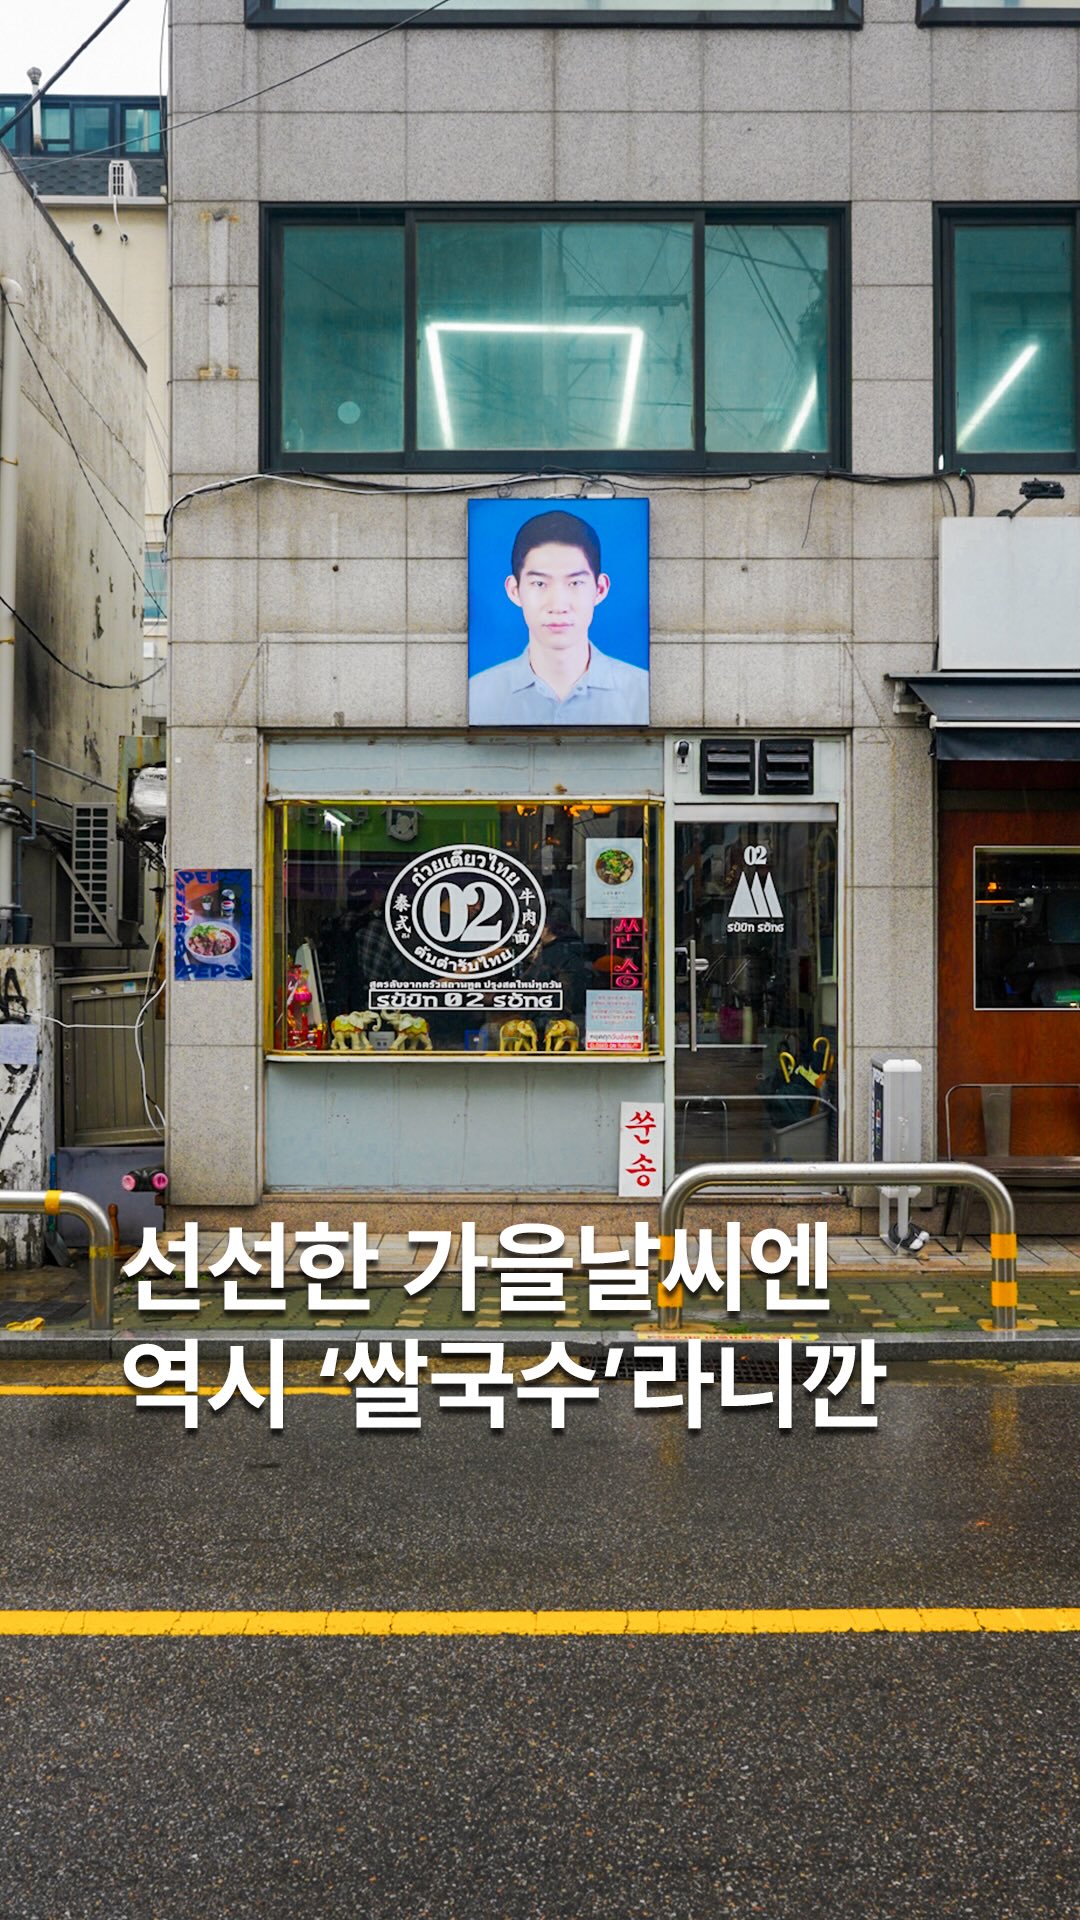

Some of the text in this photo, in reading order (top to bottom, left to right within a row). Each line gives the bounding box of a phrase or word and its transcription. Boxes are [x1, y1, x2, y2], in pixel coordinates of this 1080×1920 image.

[744, 845, 767, 866] 02
[422, 881, 503, 942] 02
[444, 992, 485, 1008] 02
[625, 1110, 657, 1187] 쑨송
